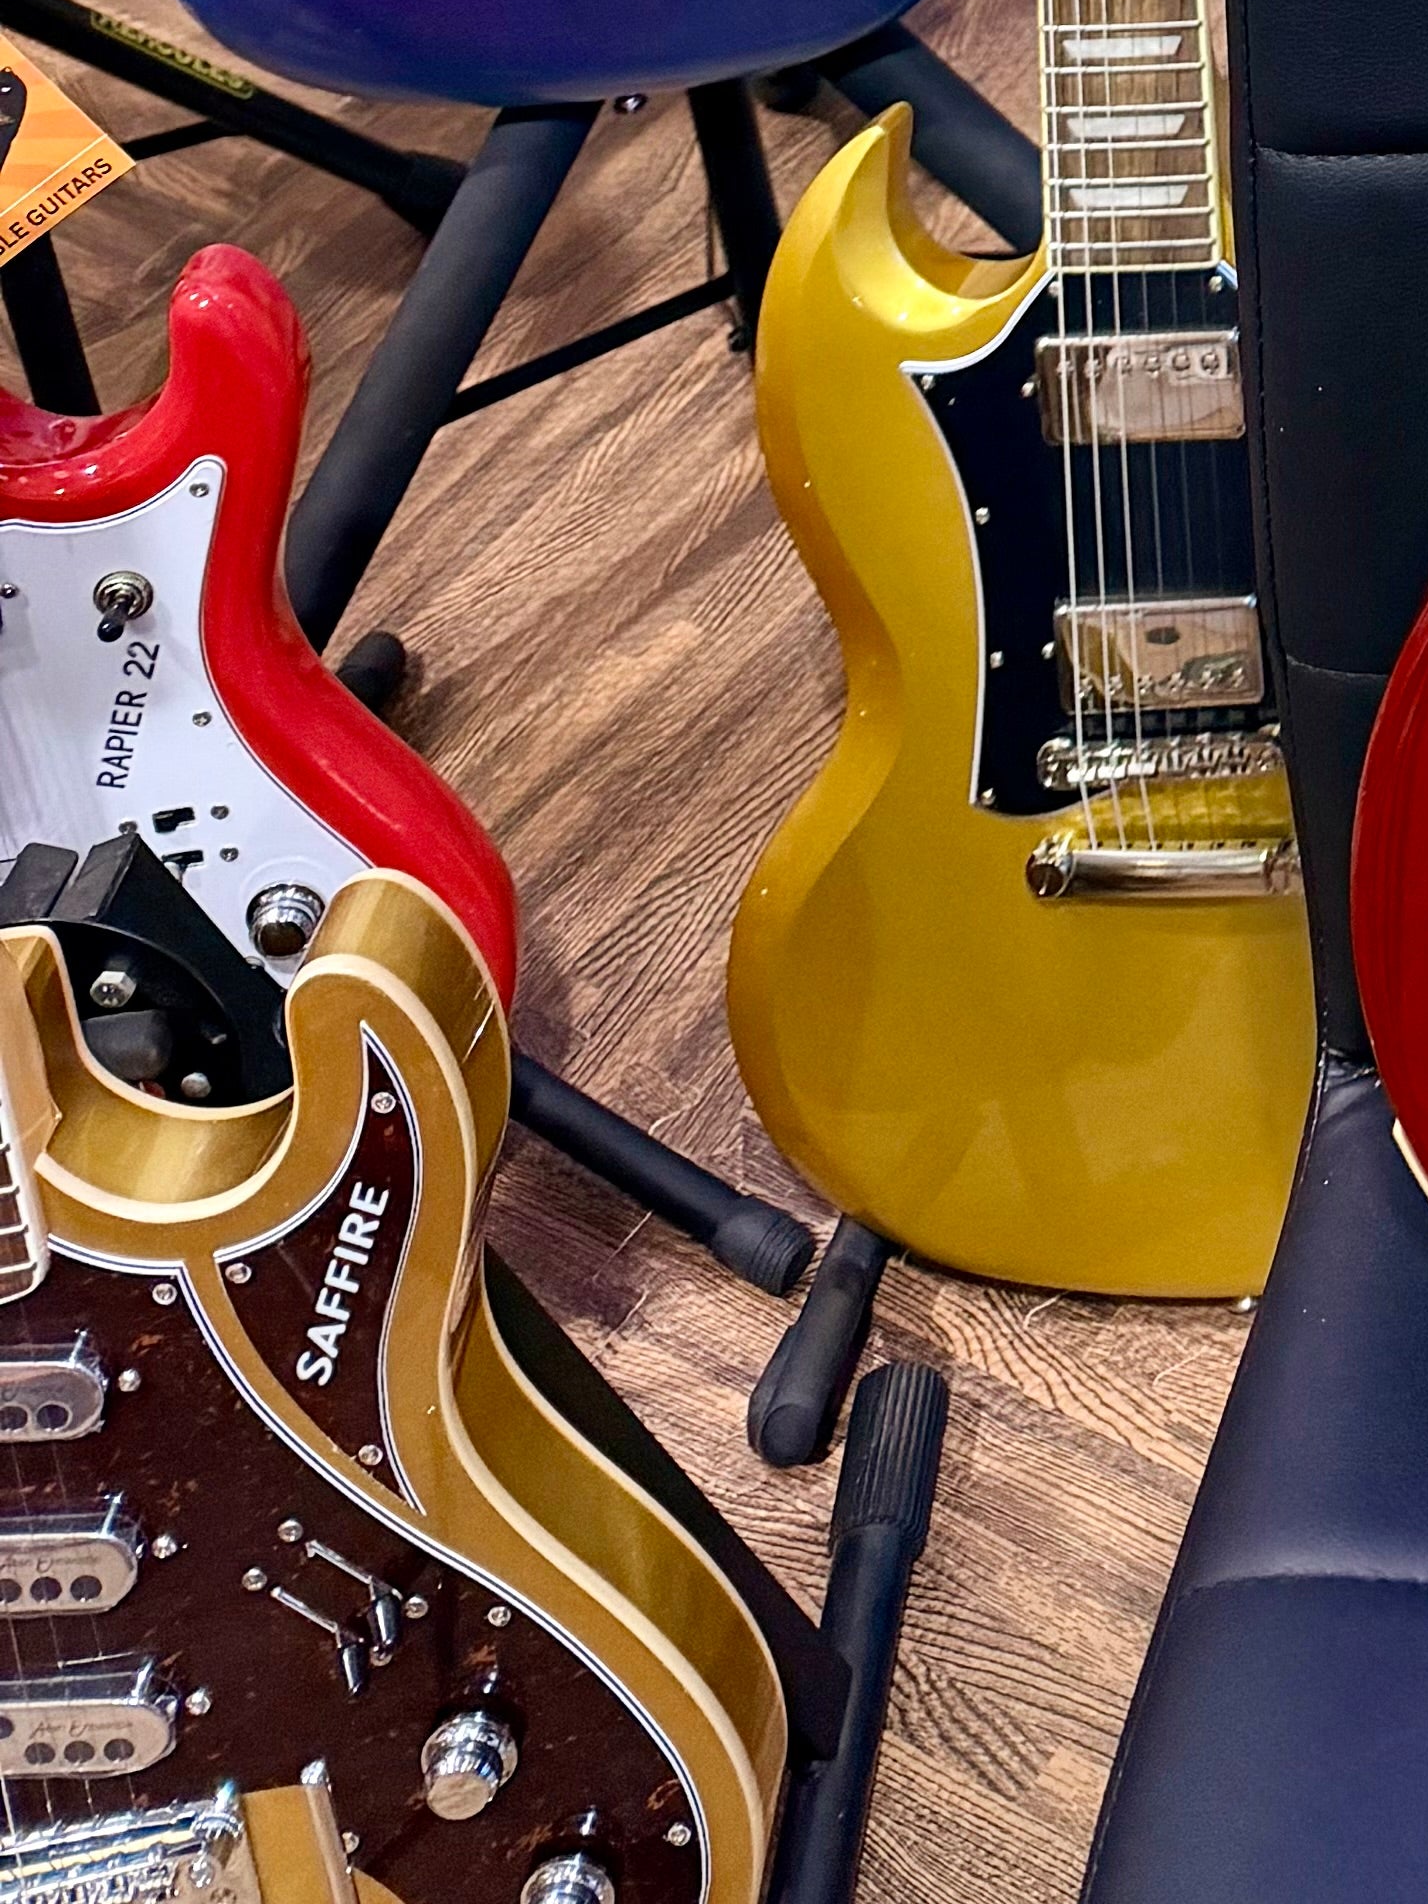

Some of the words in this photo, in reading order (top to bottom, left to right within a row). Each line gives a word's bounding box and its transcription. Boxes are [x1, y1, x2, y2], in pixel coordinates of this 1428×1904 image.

[25, 157, 113, 227] GUITARS
[95, 689, 148, 790] RAPIER
[122, 640, 161, 681] 22
[295, 1180, 390, 1387] SAFFIRE
